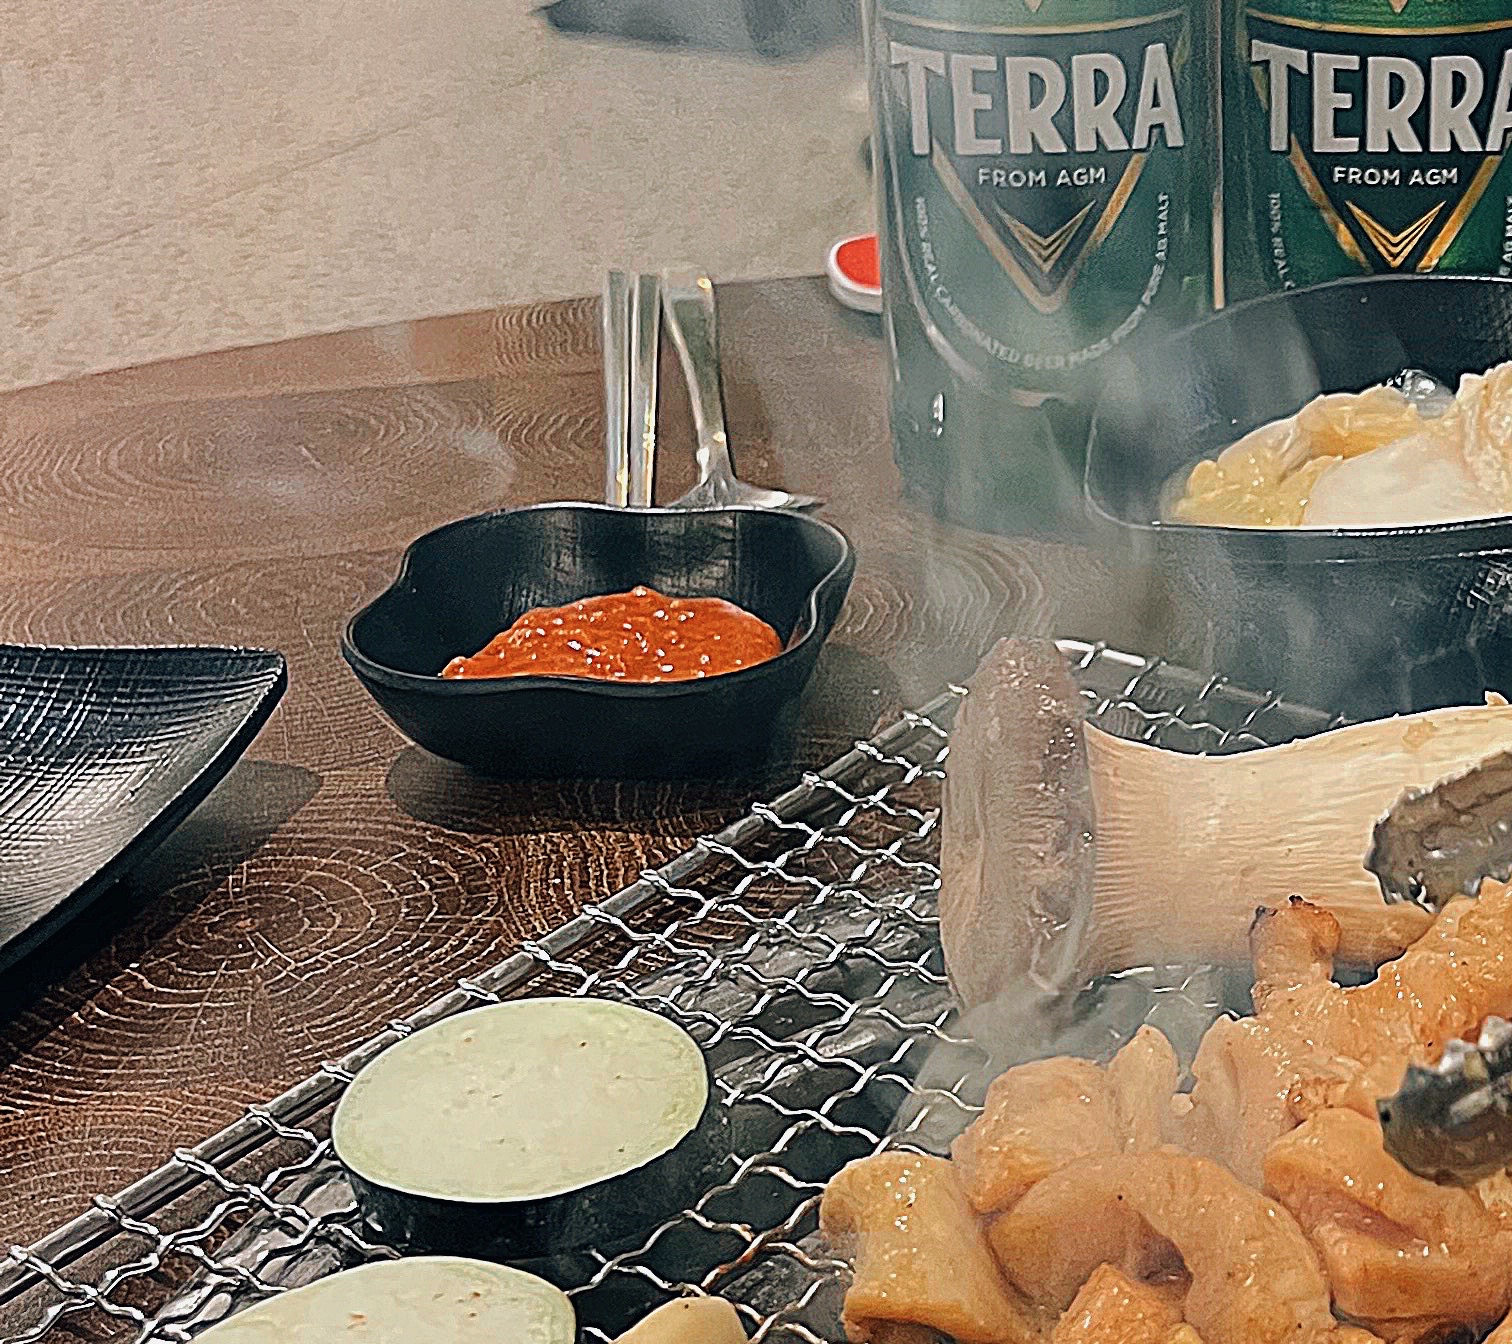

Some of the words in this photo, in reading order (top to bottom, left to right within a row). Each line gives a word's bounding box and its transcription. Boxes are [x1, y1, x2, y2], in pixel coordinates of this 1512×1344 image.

[889, 39, 1185, 156] TERRA
[977, 166, 1046, 188] FROM
[1055, 165, 1106, 187] AGM
[1333, 166, 1400, 186] FROM
[1409, 166, 1458, 187] AGM
[1156, 192, 1169, 236] MALT
[1271, 237, 1289, 279] REAL
